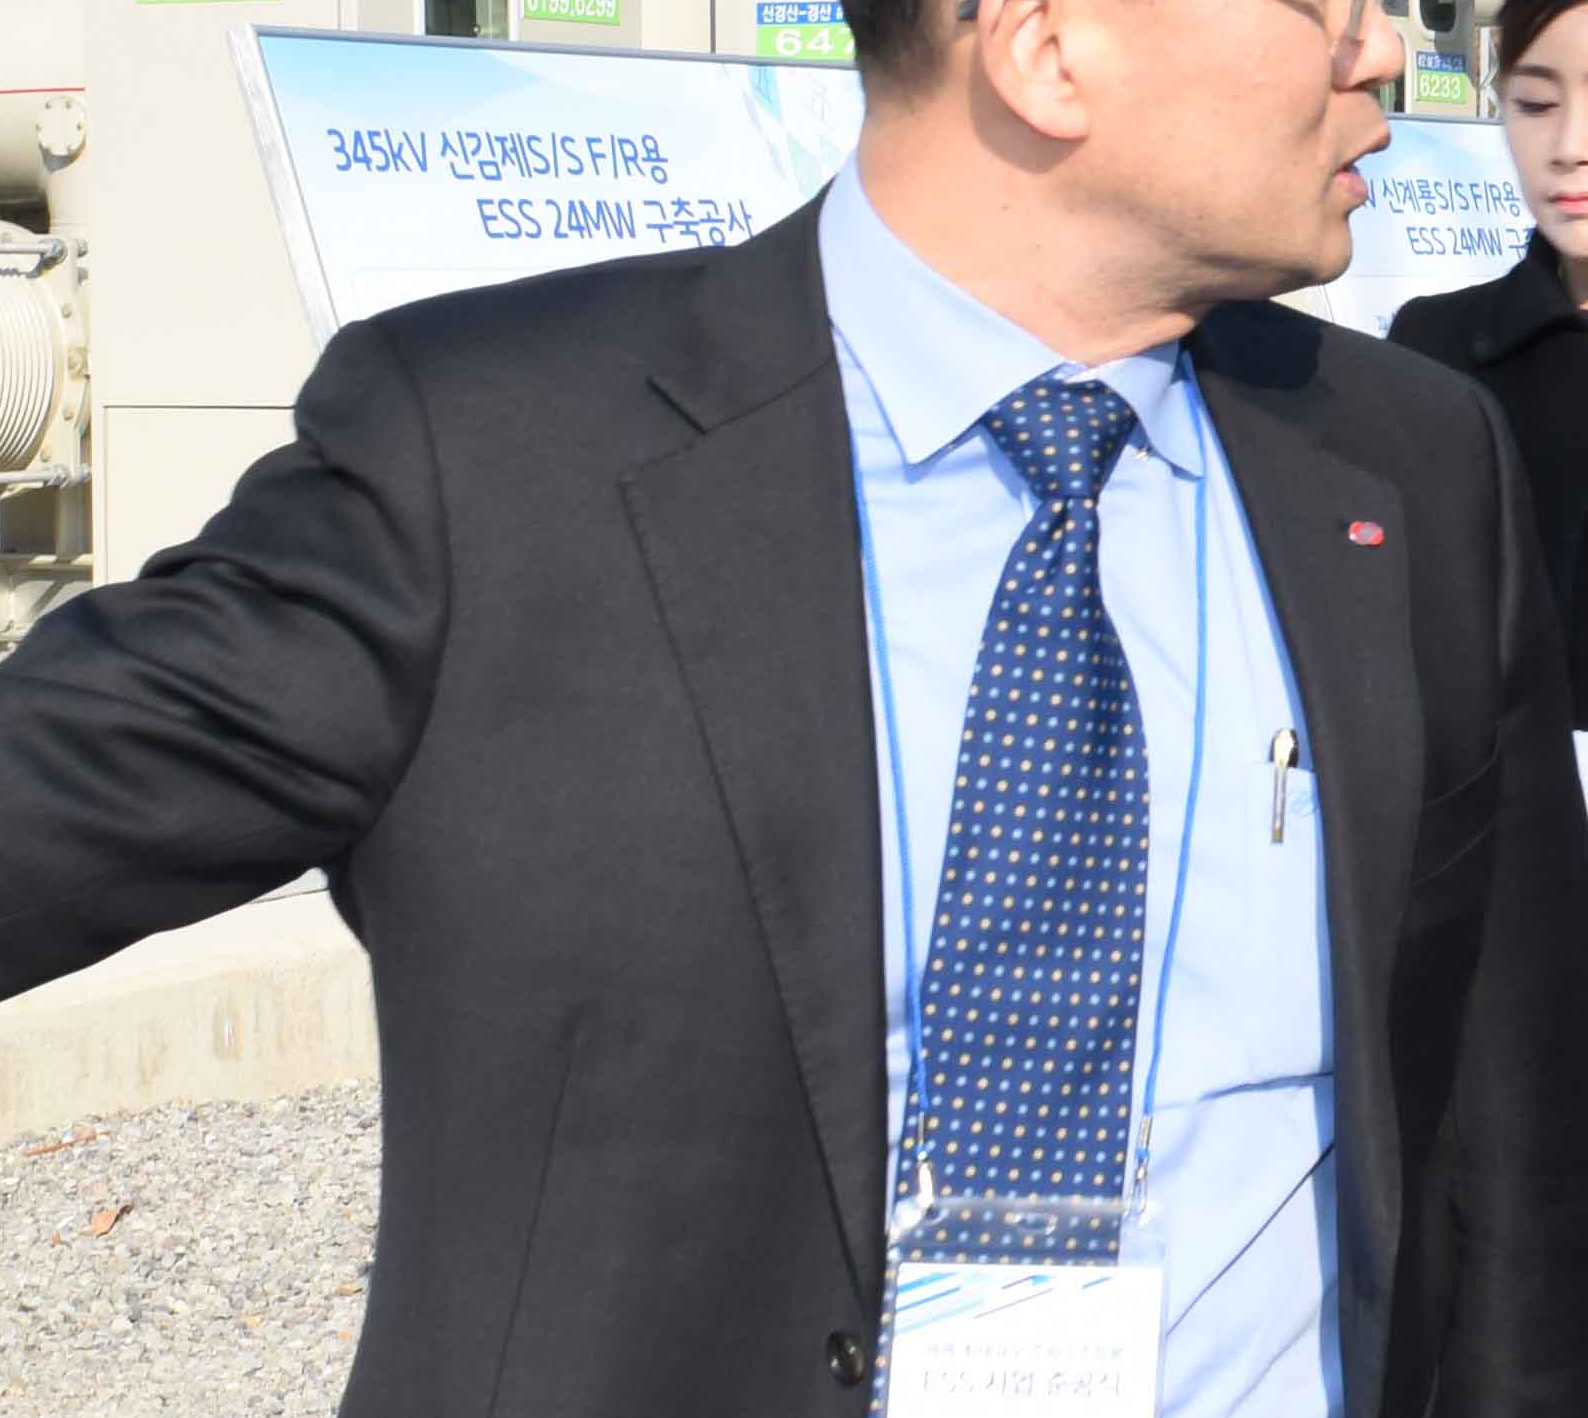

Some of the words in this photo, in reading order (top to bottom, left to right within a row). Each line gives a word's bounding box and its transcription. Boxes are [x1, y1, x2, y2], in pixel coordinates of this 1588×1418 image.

[326, 128, 429, 174] 345kV
[440, 130, 584, 181] 신김제S/S
[588, 133, 669, 184] F/R용
[475, 198, 543, 239] ESS
[544, 198, 638, 240] 24MW
[642, 196, 754, 247] 구축공사
[1405, 226, 1447, 256] ESS
[1446, 226, 1504, 257] 24MW
